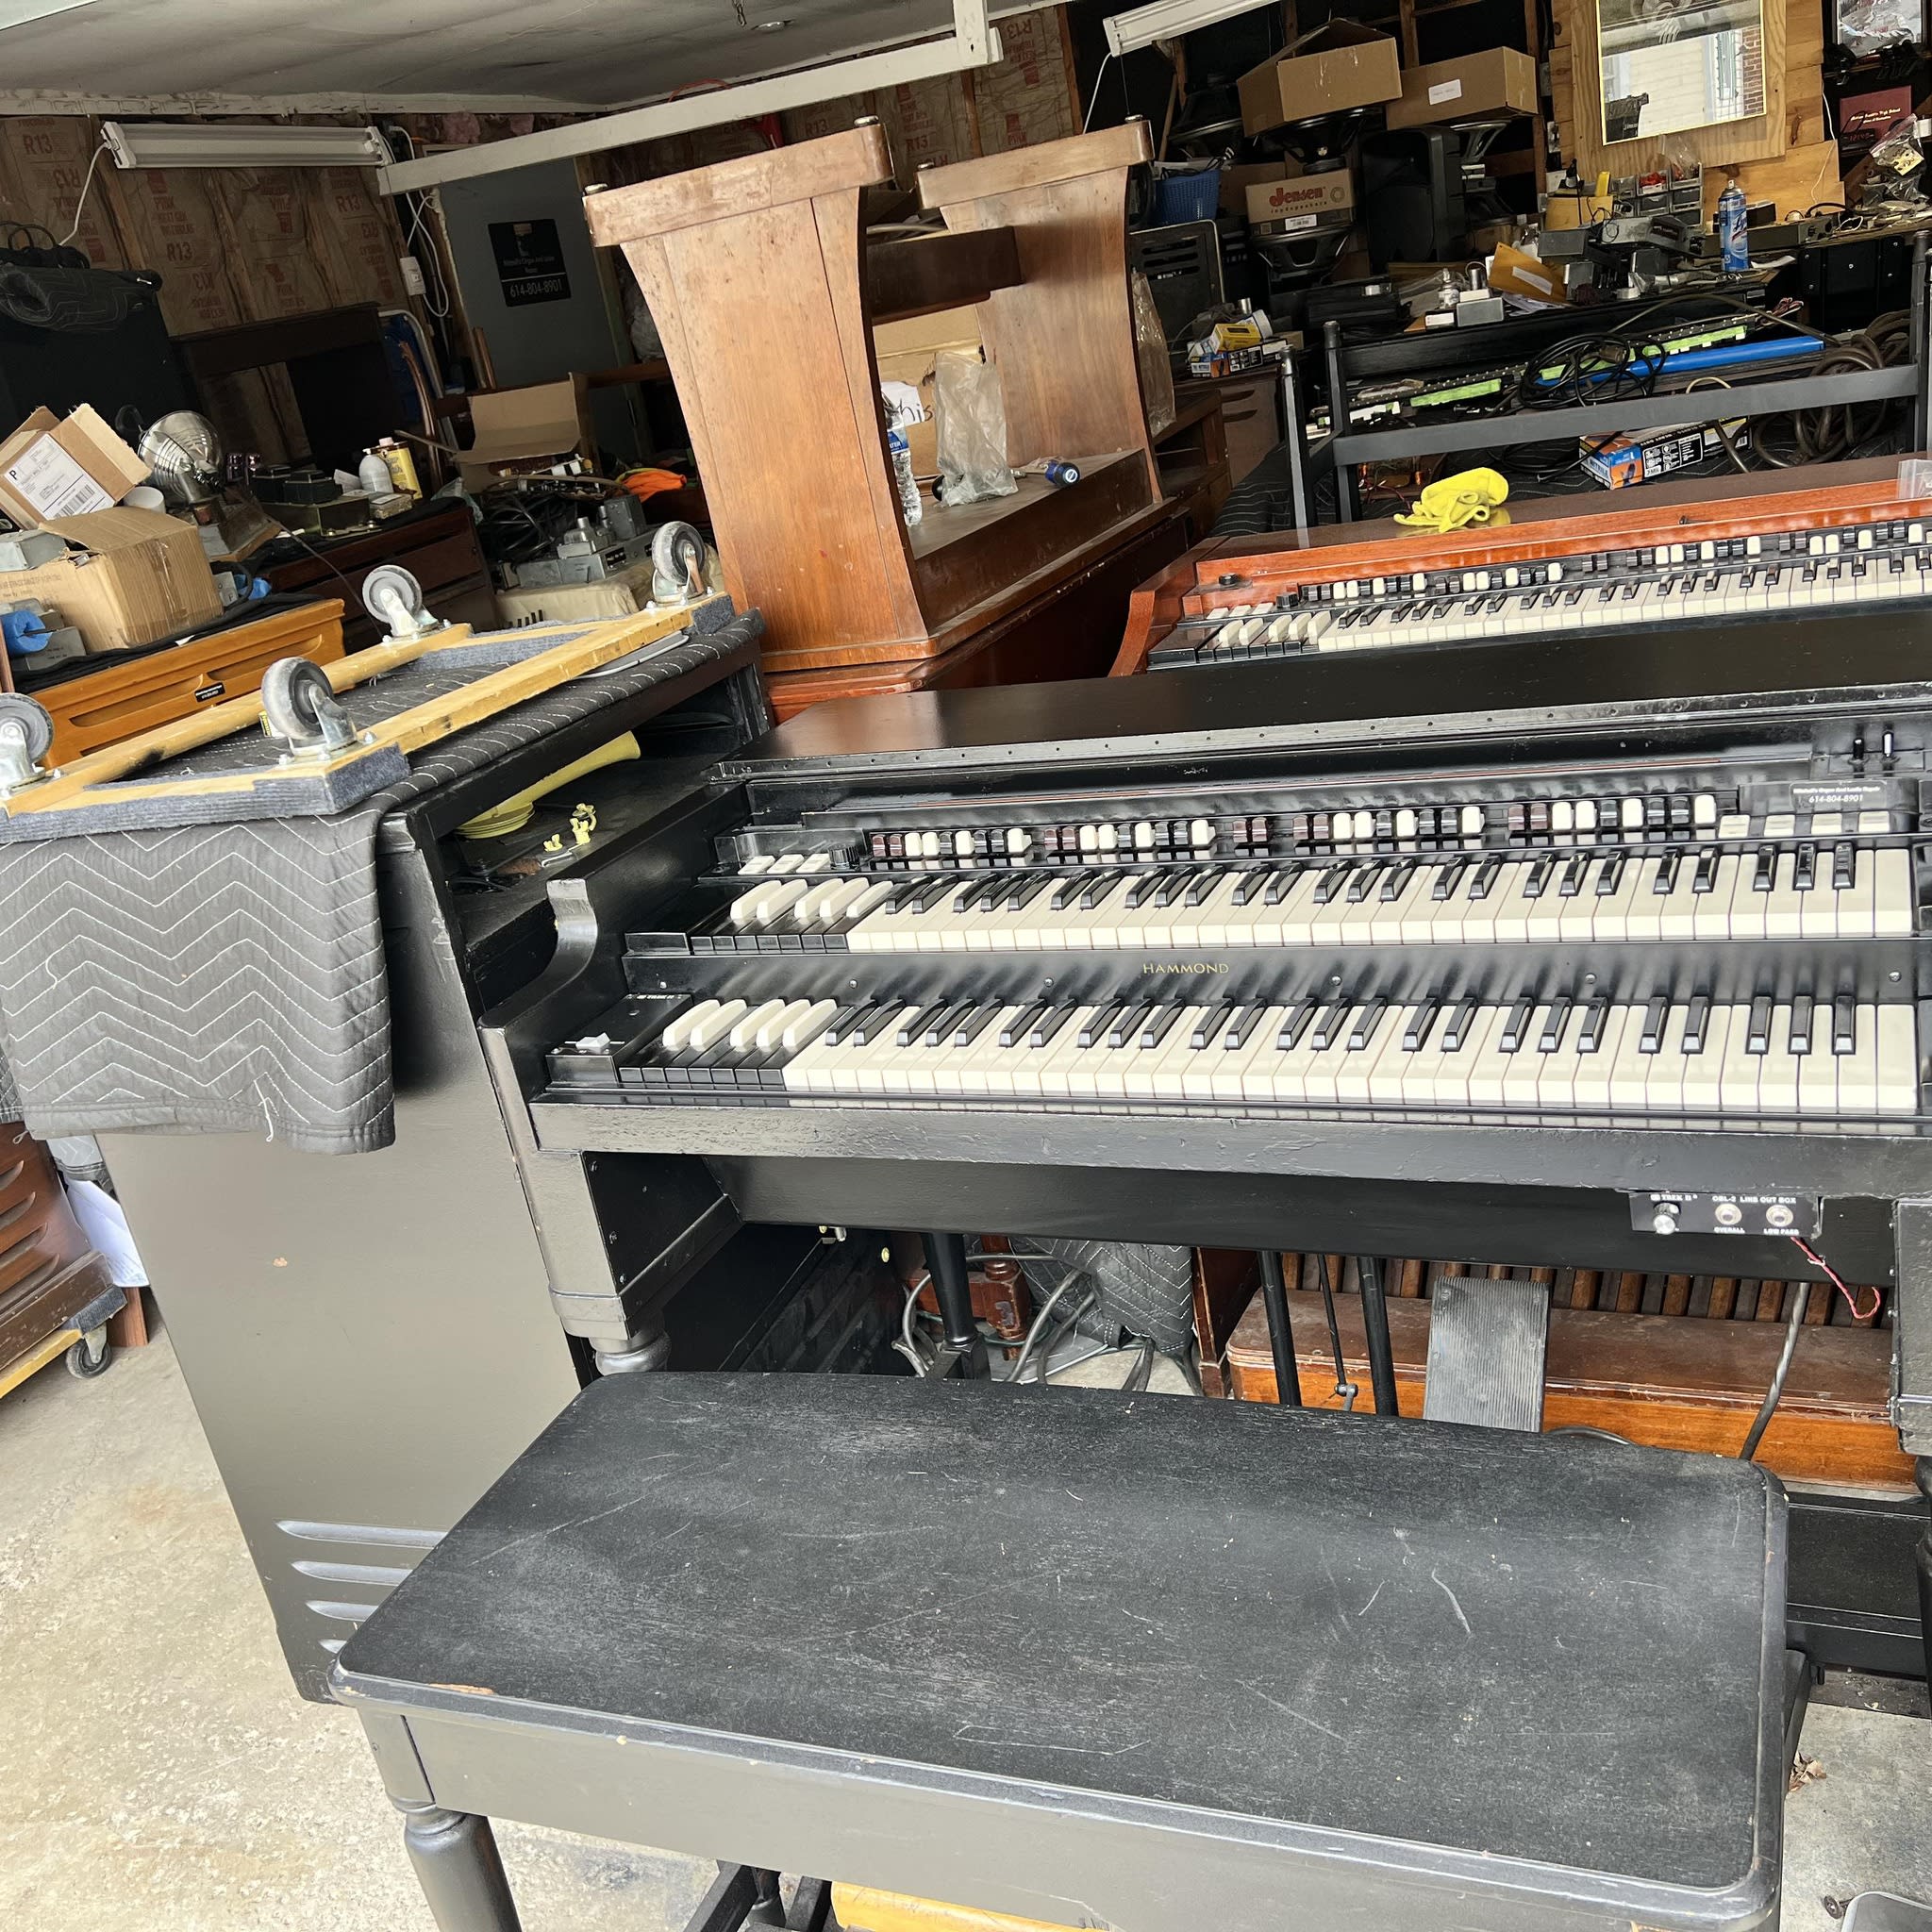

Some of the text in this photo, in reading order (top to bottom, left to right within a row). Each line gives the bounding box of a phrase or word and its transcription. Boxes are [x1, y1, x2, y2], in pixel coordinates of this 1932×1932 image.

[22, 134, 54, 156] R13
[906, 135, 929, 153] R13
[53, 167, 82, 189] R13
[335, 194, 363, 213] R13
[1269, 187, 1324, 208] Jensen
[166, 241, 193, 263] R13
[510, 278, 563, 298] 614-804-8901
[8, 470, 18, 481] P
[1808, 794, 1864, 804] 614-804-8901
[1142, 962, 1229, 974] HAMMOND
